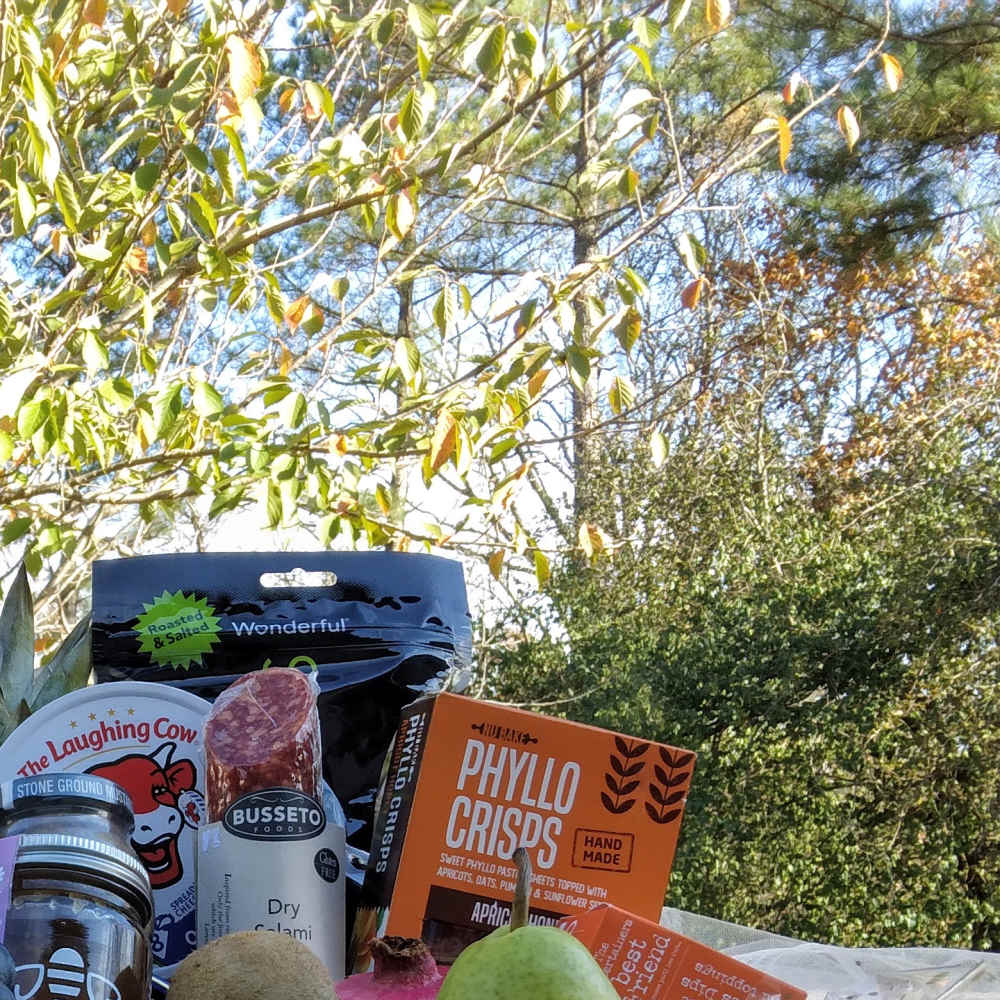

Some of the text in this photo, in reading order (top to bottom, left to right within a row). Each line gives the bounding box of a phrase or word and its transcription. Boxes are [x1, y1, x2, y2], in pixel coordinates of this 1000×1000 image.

[147, 609, 204, 635] Roasted
[231, 618, 346, 637] Wonderful
[153, 622, 210, 649] & Salted
[16, 717, 199, 777] The Laughing Cow
[393, 713, 422, 791] PHYLLO
[16, 779, 54, 799] STONE
[57, 778, 104, 795] GROUND
[456, 738, 582, 815] PHYLLO
[232, 806, 321, 826] BUSSETO
[253, 825, 303, 833] FOODS
[376, 796, 401, 873] CRISPS
[445, 795, 562, 870] CRISPS
[583, 834, 623, 852] HAND
[582, 850, 621, 865] MADE
[440, 853, 465, 867] SWEET
[466, 857, 497, 874] PHYLLO
[557, 878, 586, 894] TOPPED
[586, 884, 608, 898] WITH
[267, 898, 301, 920] Dry
[533, 888, 541, 898] &
[543, 892, 588, 908] SUNFLOWER
[610, 937, 648, 986] best
